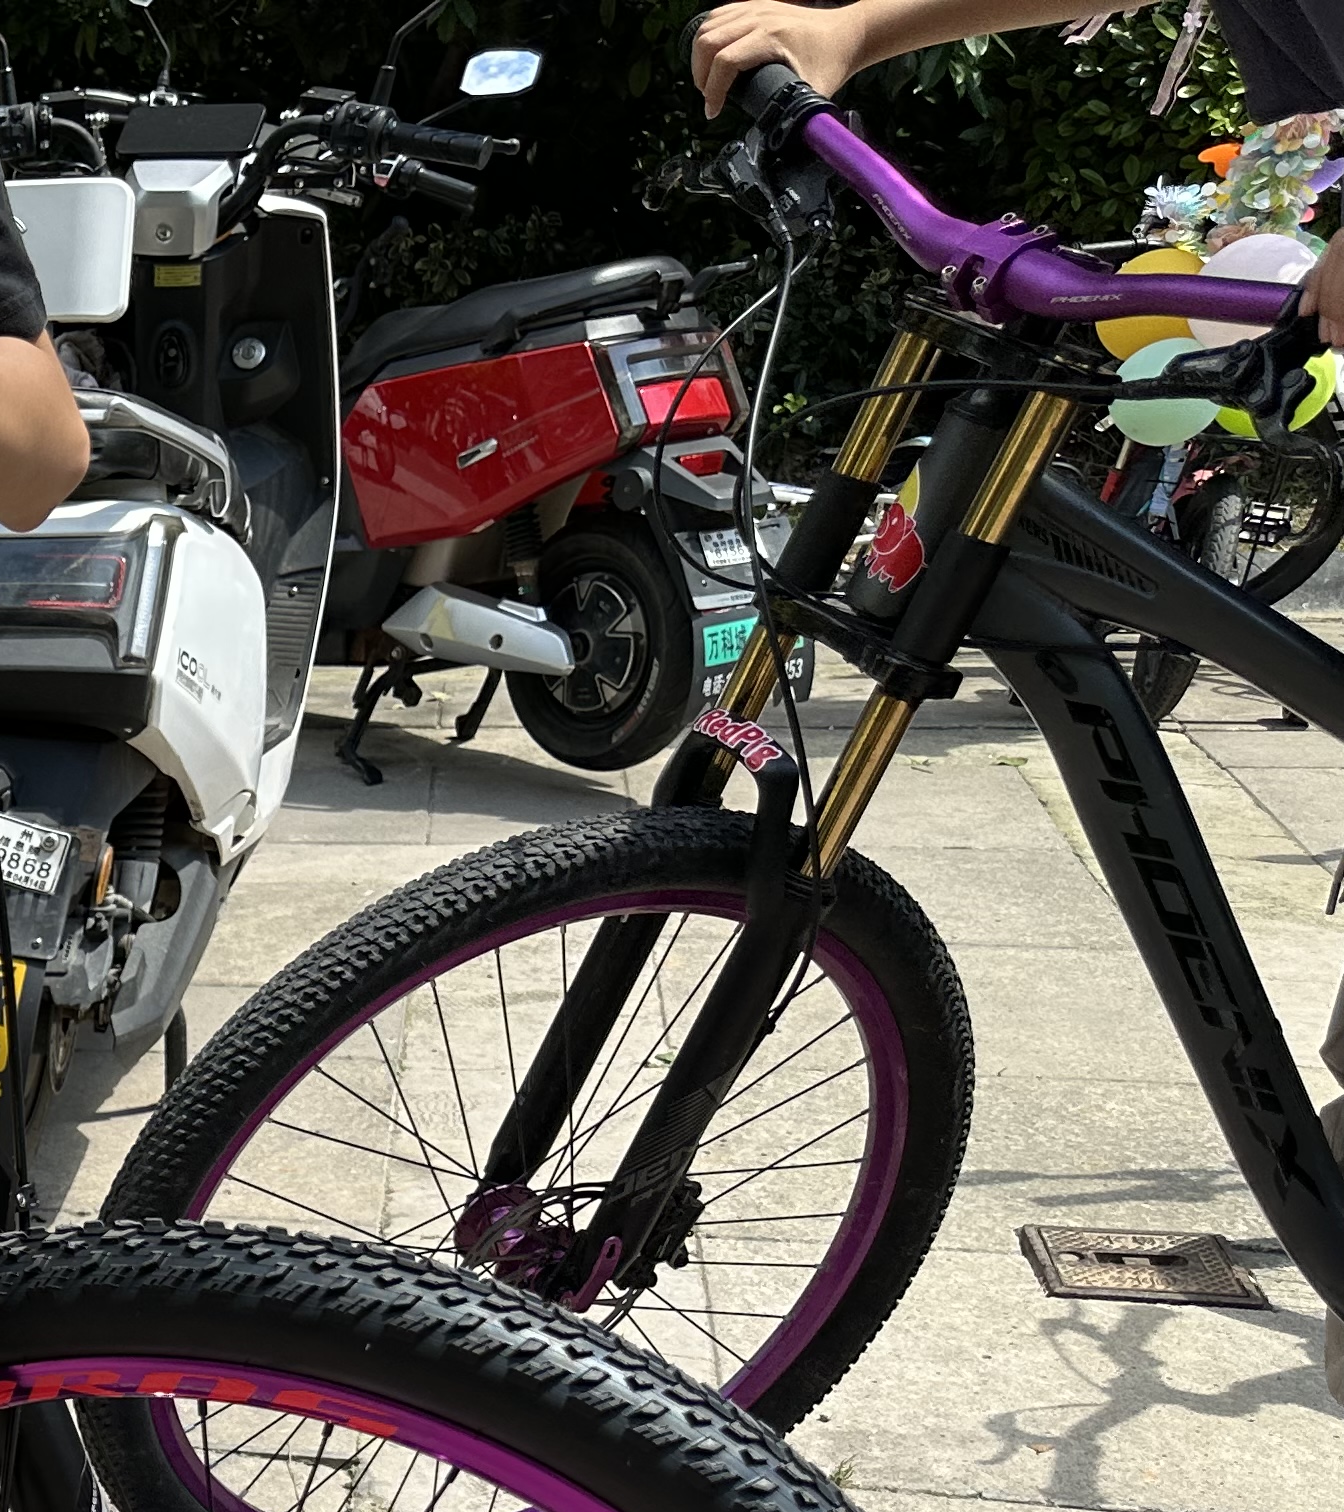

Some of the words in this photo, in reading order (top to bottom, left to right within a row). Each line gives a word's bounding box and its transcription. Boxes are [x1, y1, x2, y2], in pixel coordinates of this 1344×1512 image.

[1050, 293, 1123, 304] PHOENIX
[693, 708, 783, 773] RedPig
[1065, 701, 1328, 1211] PHOENIX
